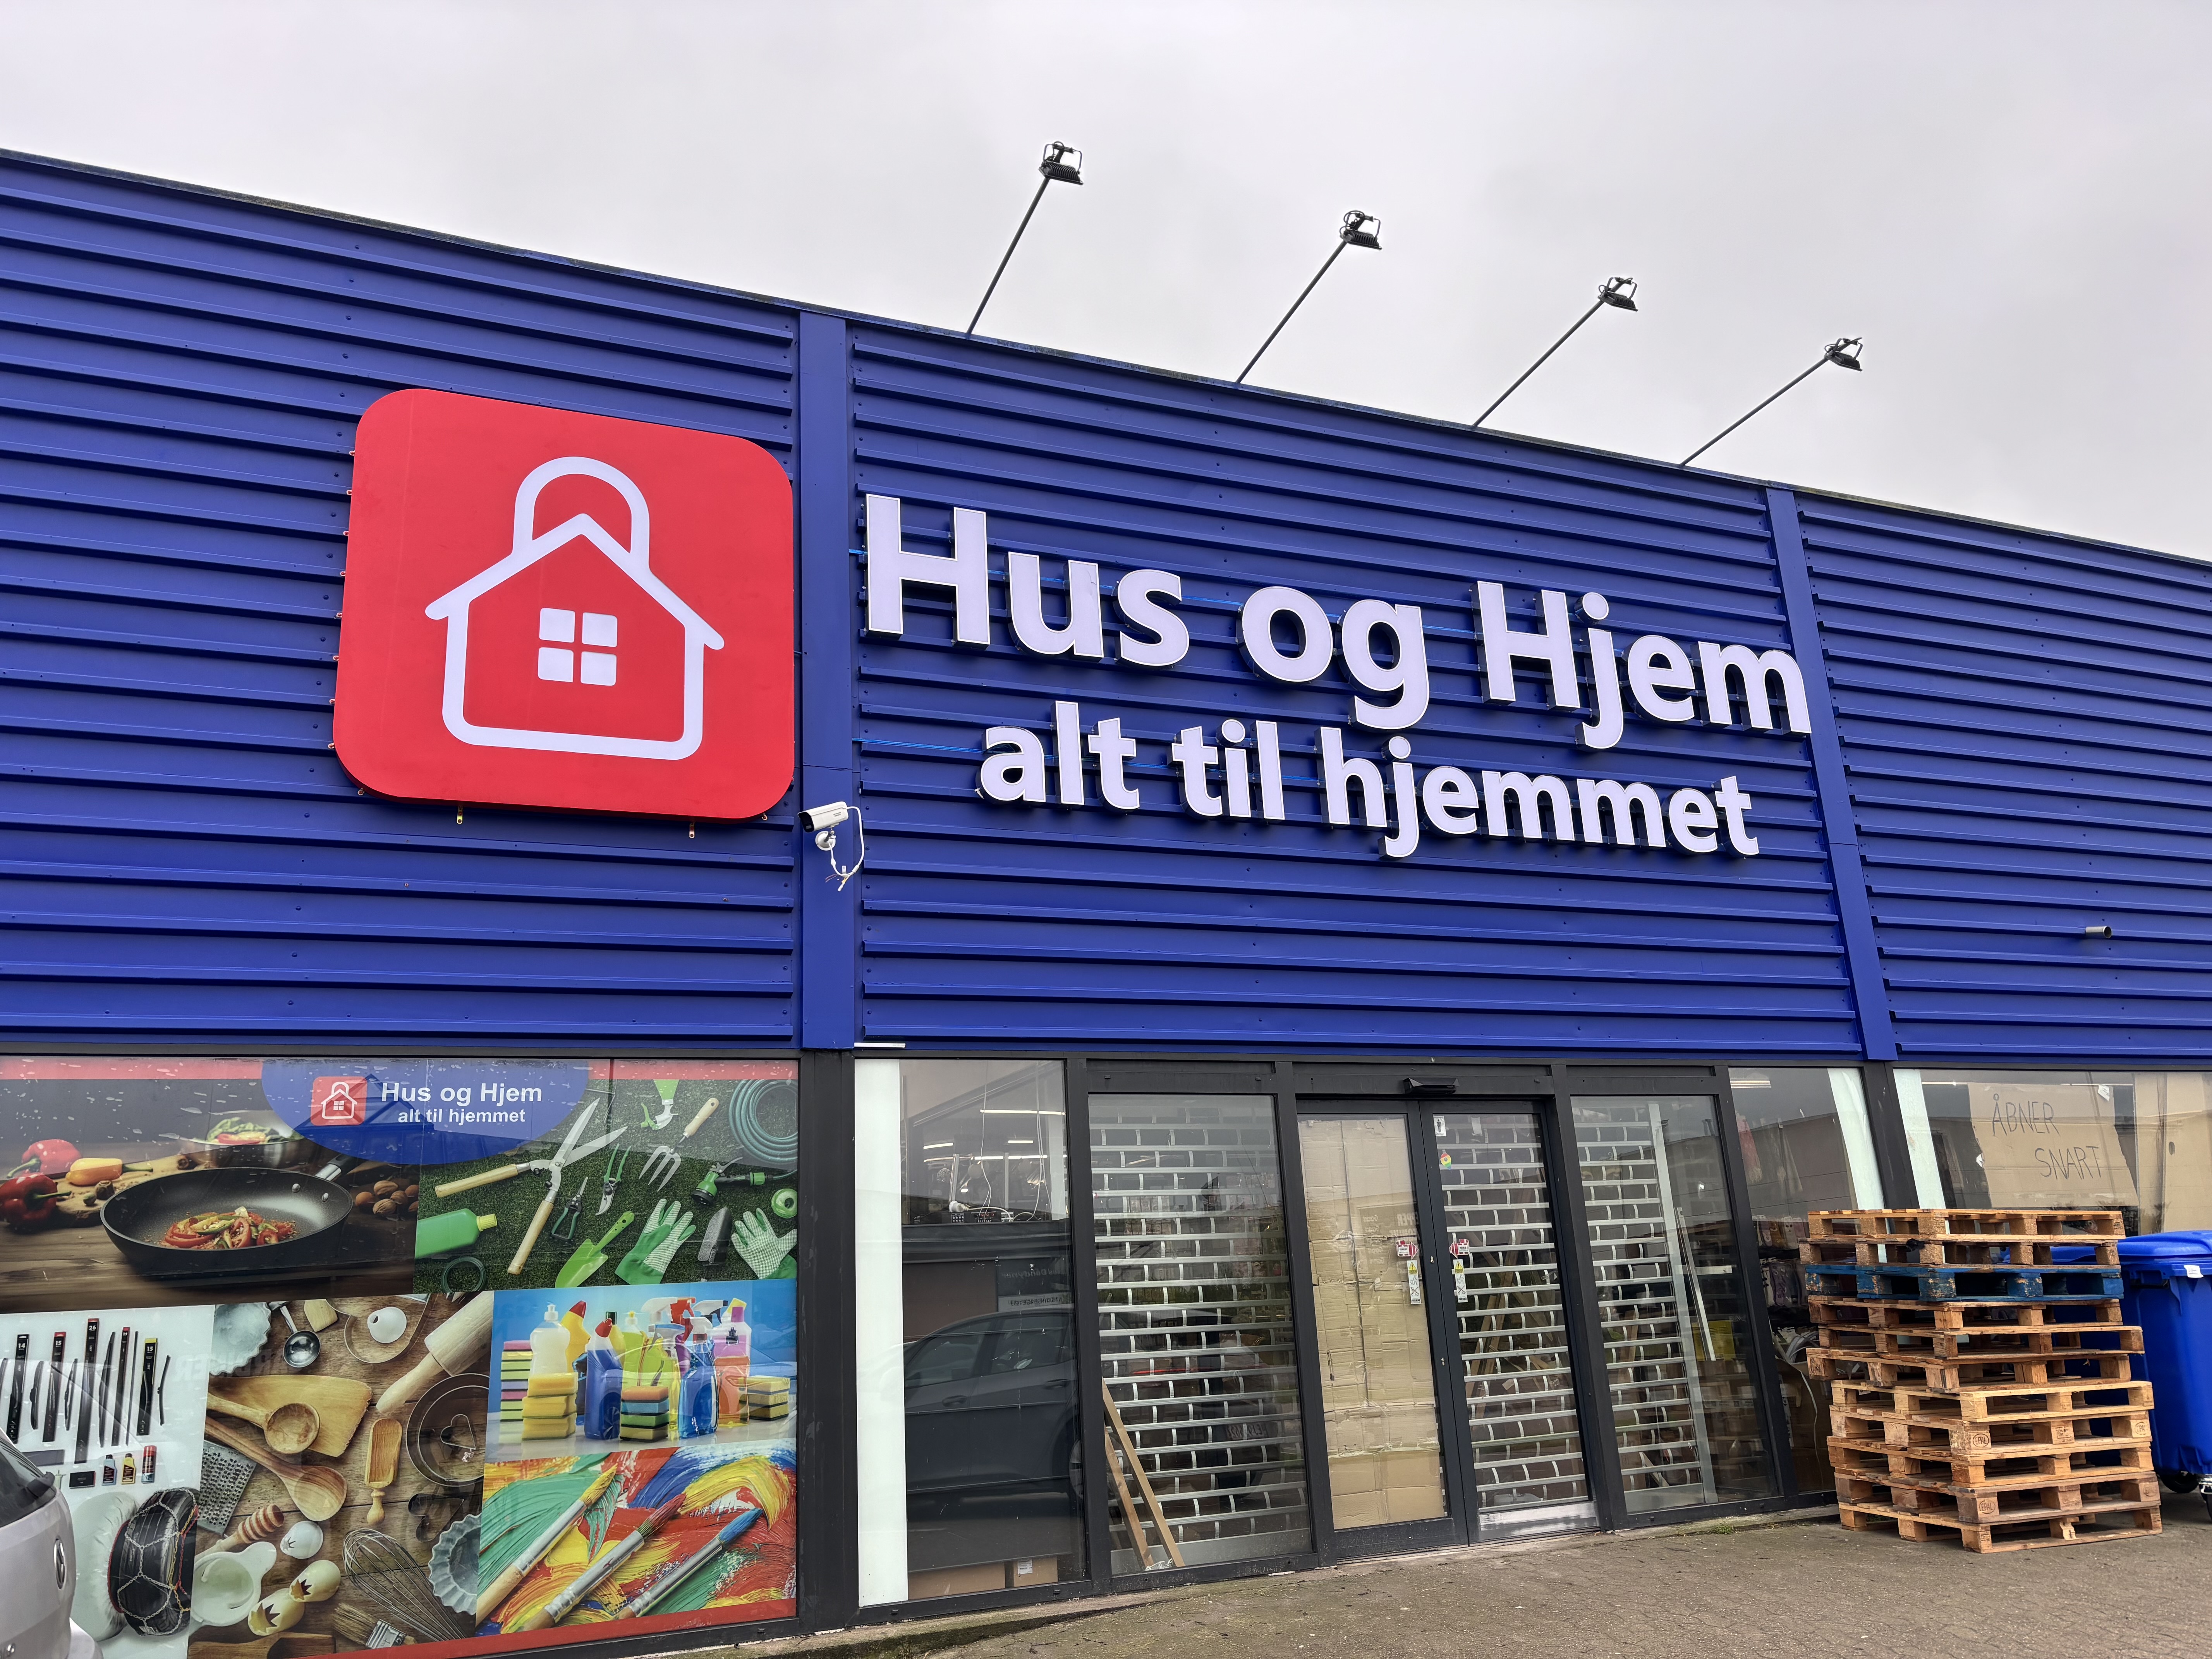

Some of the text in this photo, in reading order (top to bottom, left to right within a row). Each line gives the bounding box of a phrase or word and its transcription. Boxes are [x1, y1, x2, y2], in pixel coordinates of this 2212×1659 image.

[866, 493, 1812, 749] Hus og Hjem
[980, 700, 1760, 858] alt til hjemmet
[381, 1082, 542, 1106] Hus og Hjem
[398, 1108, 526, 1126] alt til hjemmet
[1992, 1093, 2061, 1137] ÅBNER
[2035, 1146, 2102, 1180] SNART
[1974, 1435, 1989, 1446] EPAL
[1980, 1502, 1995, 1512] EPAL
